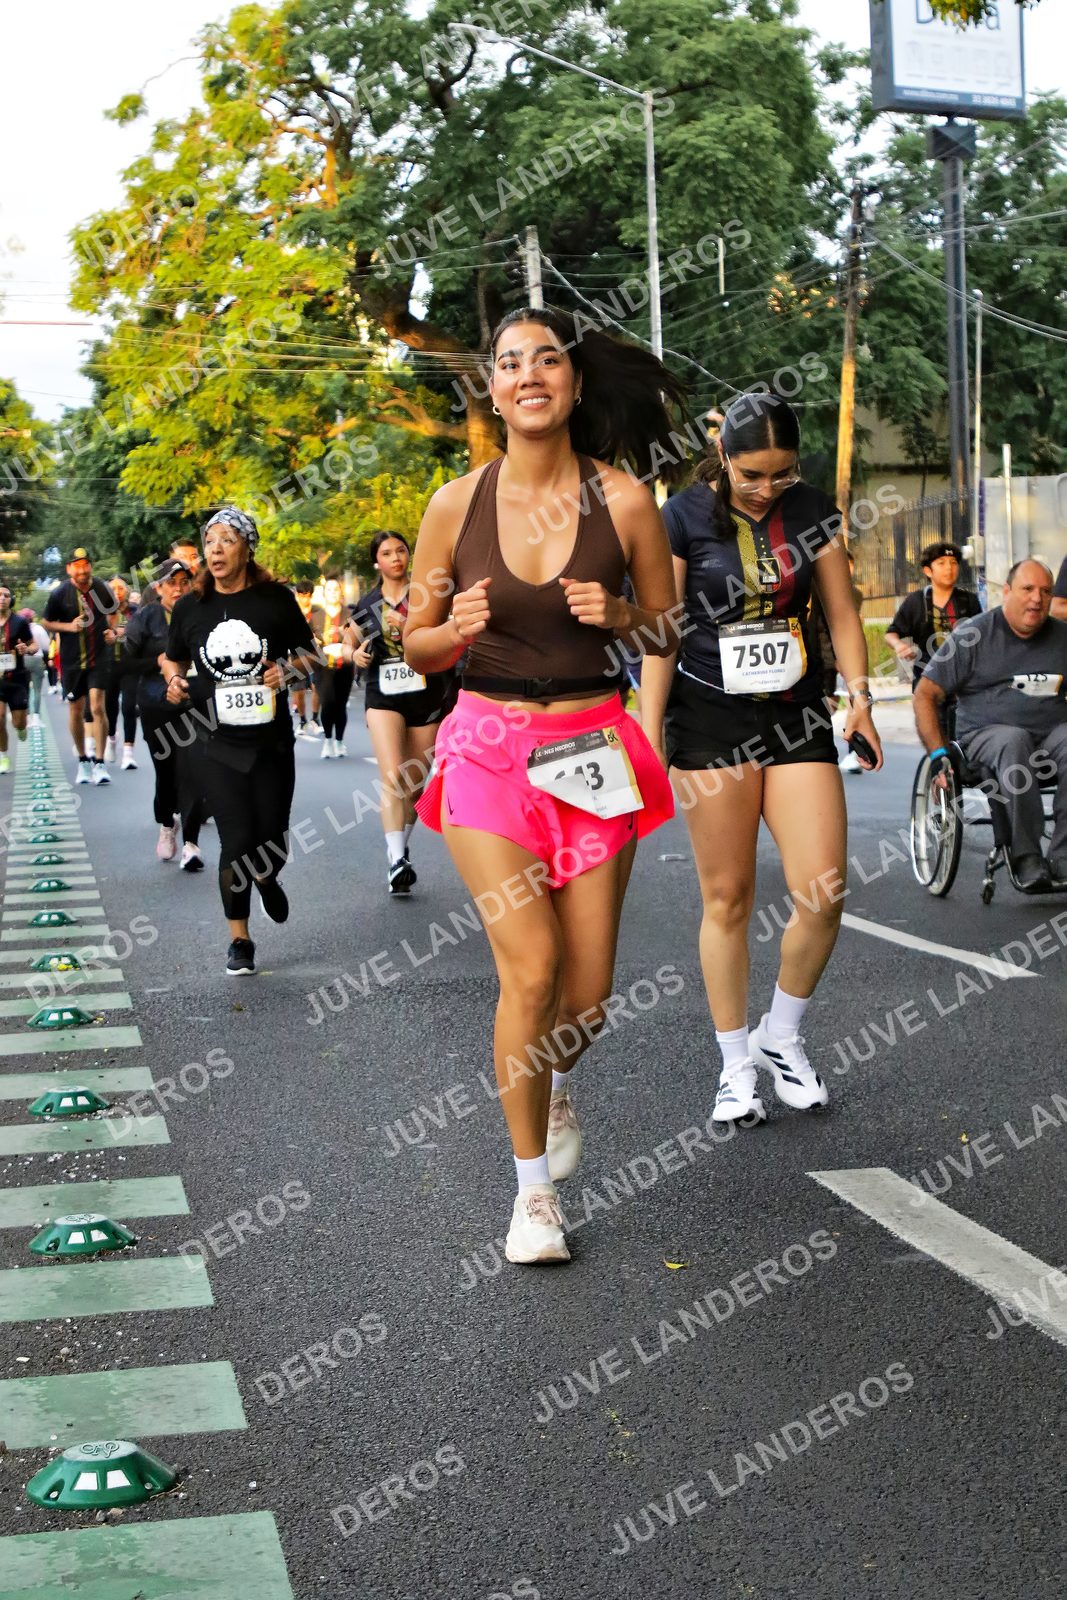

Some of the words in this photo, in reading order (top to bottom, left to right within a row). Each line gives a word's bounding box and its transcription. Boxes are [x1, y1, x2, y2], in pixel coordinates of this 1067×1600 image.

[733, 642, 789, 668] 7507
[385, 667, 414, 681] 4786
[225, 691, 264, 709] 3838
